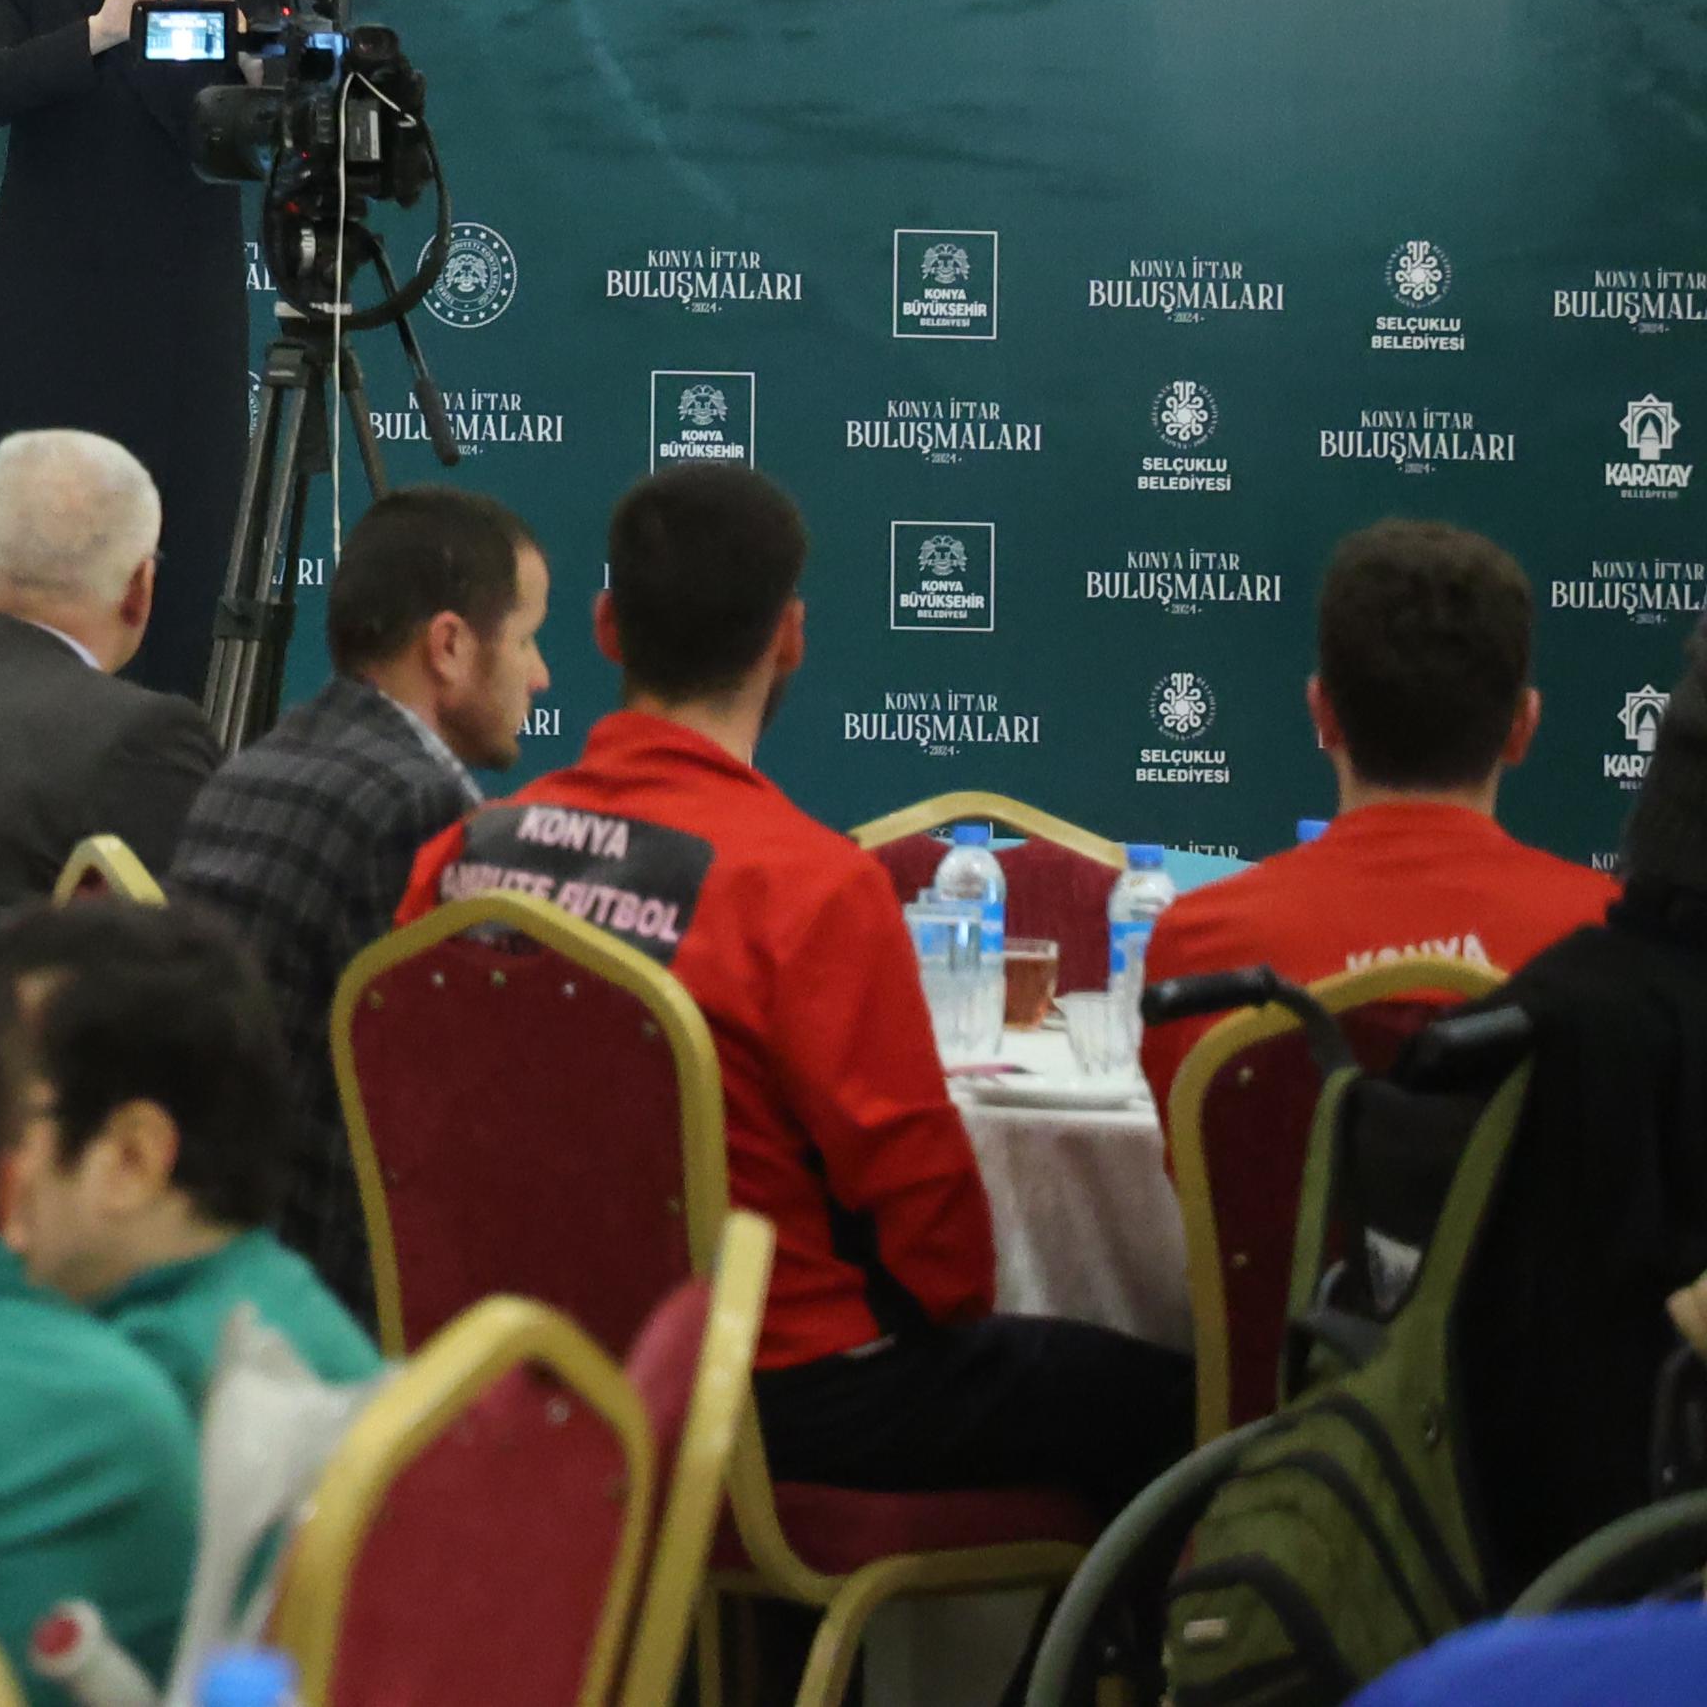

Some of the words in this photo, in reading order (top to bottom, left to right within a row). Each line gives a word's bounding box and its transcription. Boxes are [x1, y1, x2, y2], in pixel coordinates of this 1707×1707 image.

[648, 249, 704, 268] KONYA
[710, 246, 760, 269] İFTAR
[1130, 260, 1187, 278] KONYA
[1192, 255, 1243, 280] İFTAR
[606, 269, 802, 304] BULUŞMALARI
[1594, 270, 1651, 289] KONYA
[1657, 267, 1707, 290] İFTAR
[924, 288, 967, 300] KONYA
[1088, 279, 1284, 314] BULUŞMALARI
[1554, 291, 1707, 323] BULUŞMAL
[1376, 316, 1461, 334] SELÇUKLU
[1371, 334, 1465, 351] BELEDİYESİ
[409, 392, 465, 410] KYA
[471, 388, 521, 411] İFTAR
[887, 400, 944, 419] KONYA
[950, 397, 1000, 420] İFTAR
[1361, 410, 1417, 429] KONYA
[1423, 407, 1473, 430] İFTAR
[681, 429, 724, 442] KONYA
[846, 420, 1041, 455] BULUŞMALARI
[1320, 430, 1514, 465] BULUŞMALARI
[1142, 457, 1228, 475] SELÇUKLU
[1605, 463, 1693, 488] KARATAY
[1137, 474, 1231, 492] BELEDİYESİ
[1127, 551, 1183, 570] KONYA
[1189, 548, 1240, 571] İFTAR
[1592, 560, 1648, 579] KONYA
[1654, 558, 1705, 581] İFTAR
[921, 580, 964, 594] KONYA
[1086, 571, 1281, 605] BULUŞMALARI
[1551, 582, 1707, 615] BULUŞMAL
[885, 692, 941, 711] KONYA
[948, 689, 998, 712] İFTAR
[844, 712, 1039, 747] BULUŞMALARI
[1140, 748, 1226, 766] SELÇUKLU
[1136, 765, 1230, 784] BELEDİYESİ
[516, 806, 630, 860] KONYA
